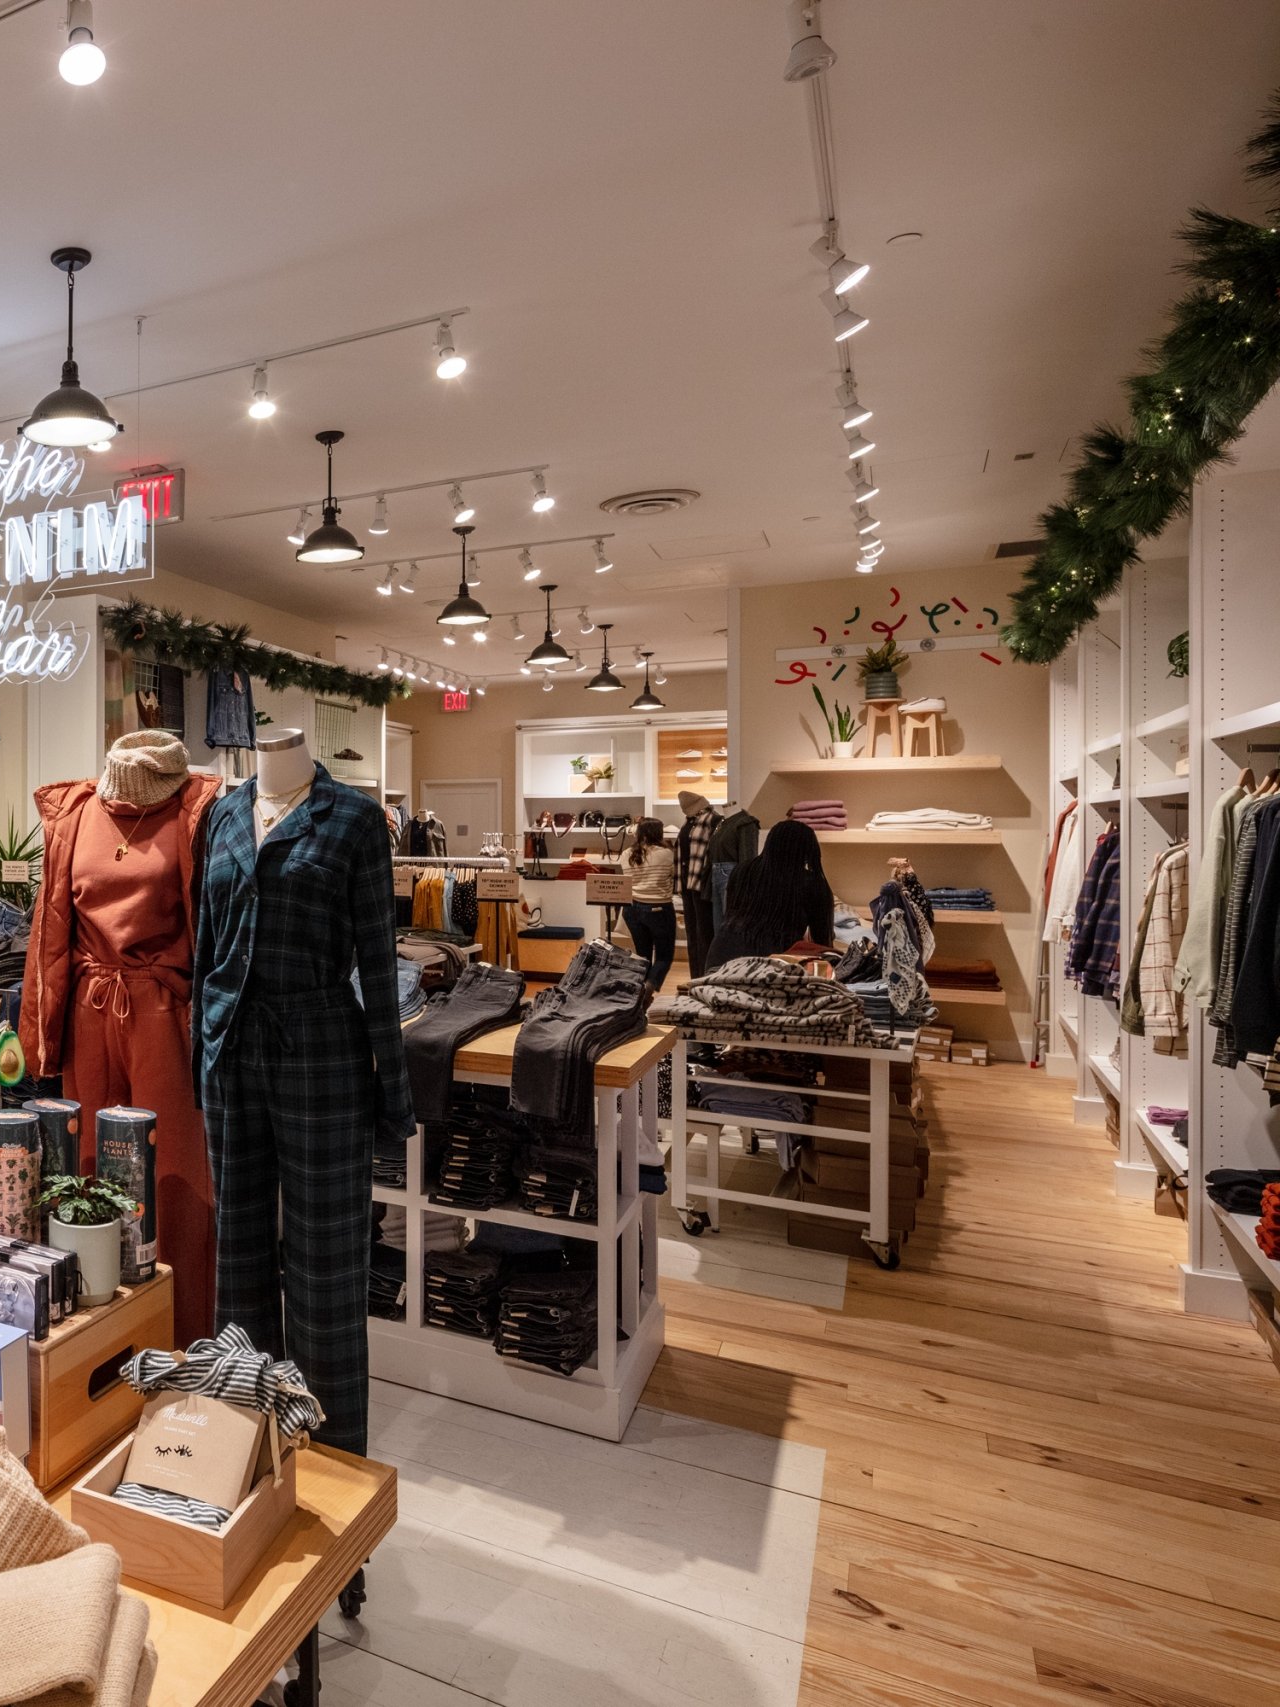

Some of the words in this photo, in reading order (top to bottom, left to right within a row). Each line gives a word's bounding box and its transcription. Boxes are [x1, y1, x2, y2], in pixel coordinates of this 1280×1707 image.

[444, 692, 467, 710] EXIT
[103, 1140, 132, 1149] HOUSE
[102, 1146, 133, 1157] PLANTS
